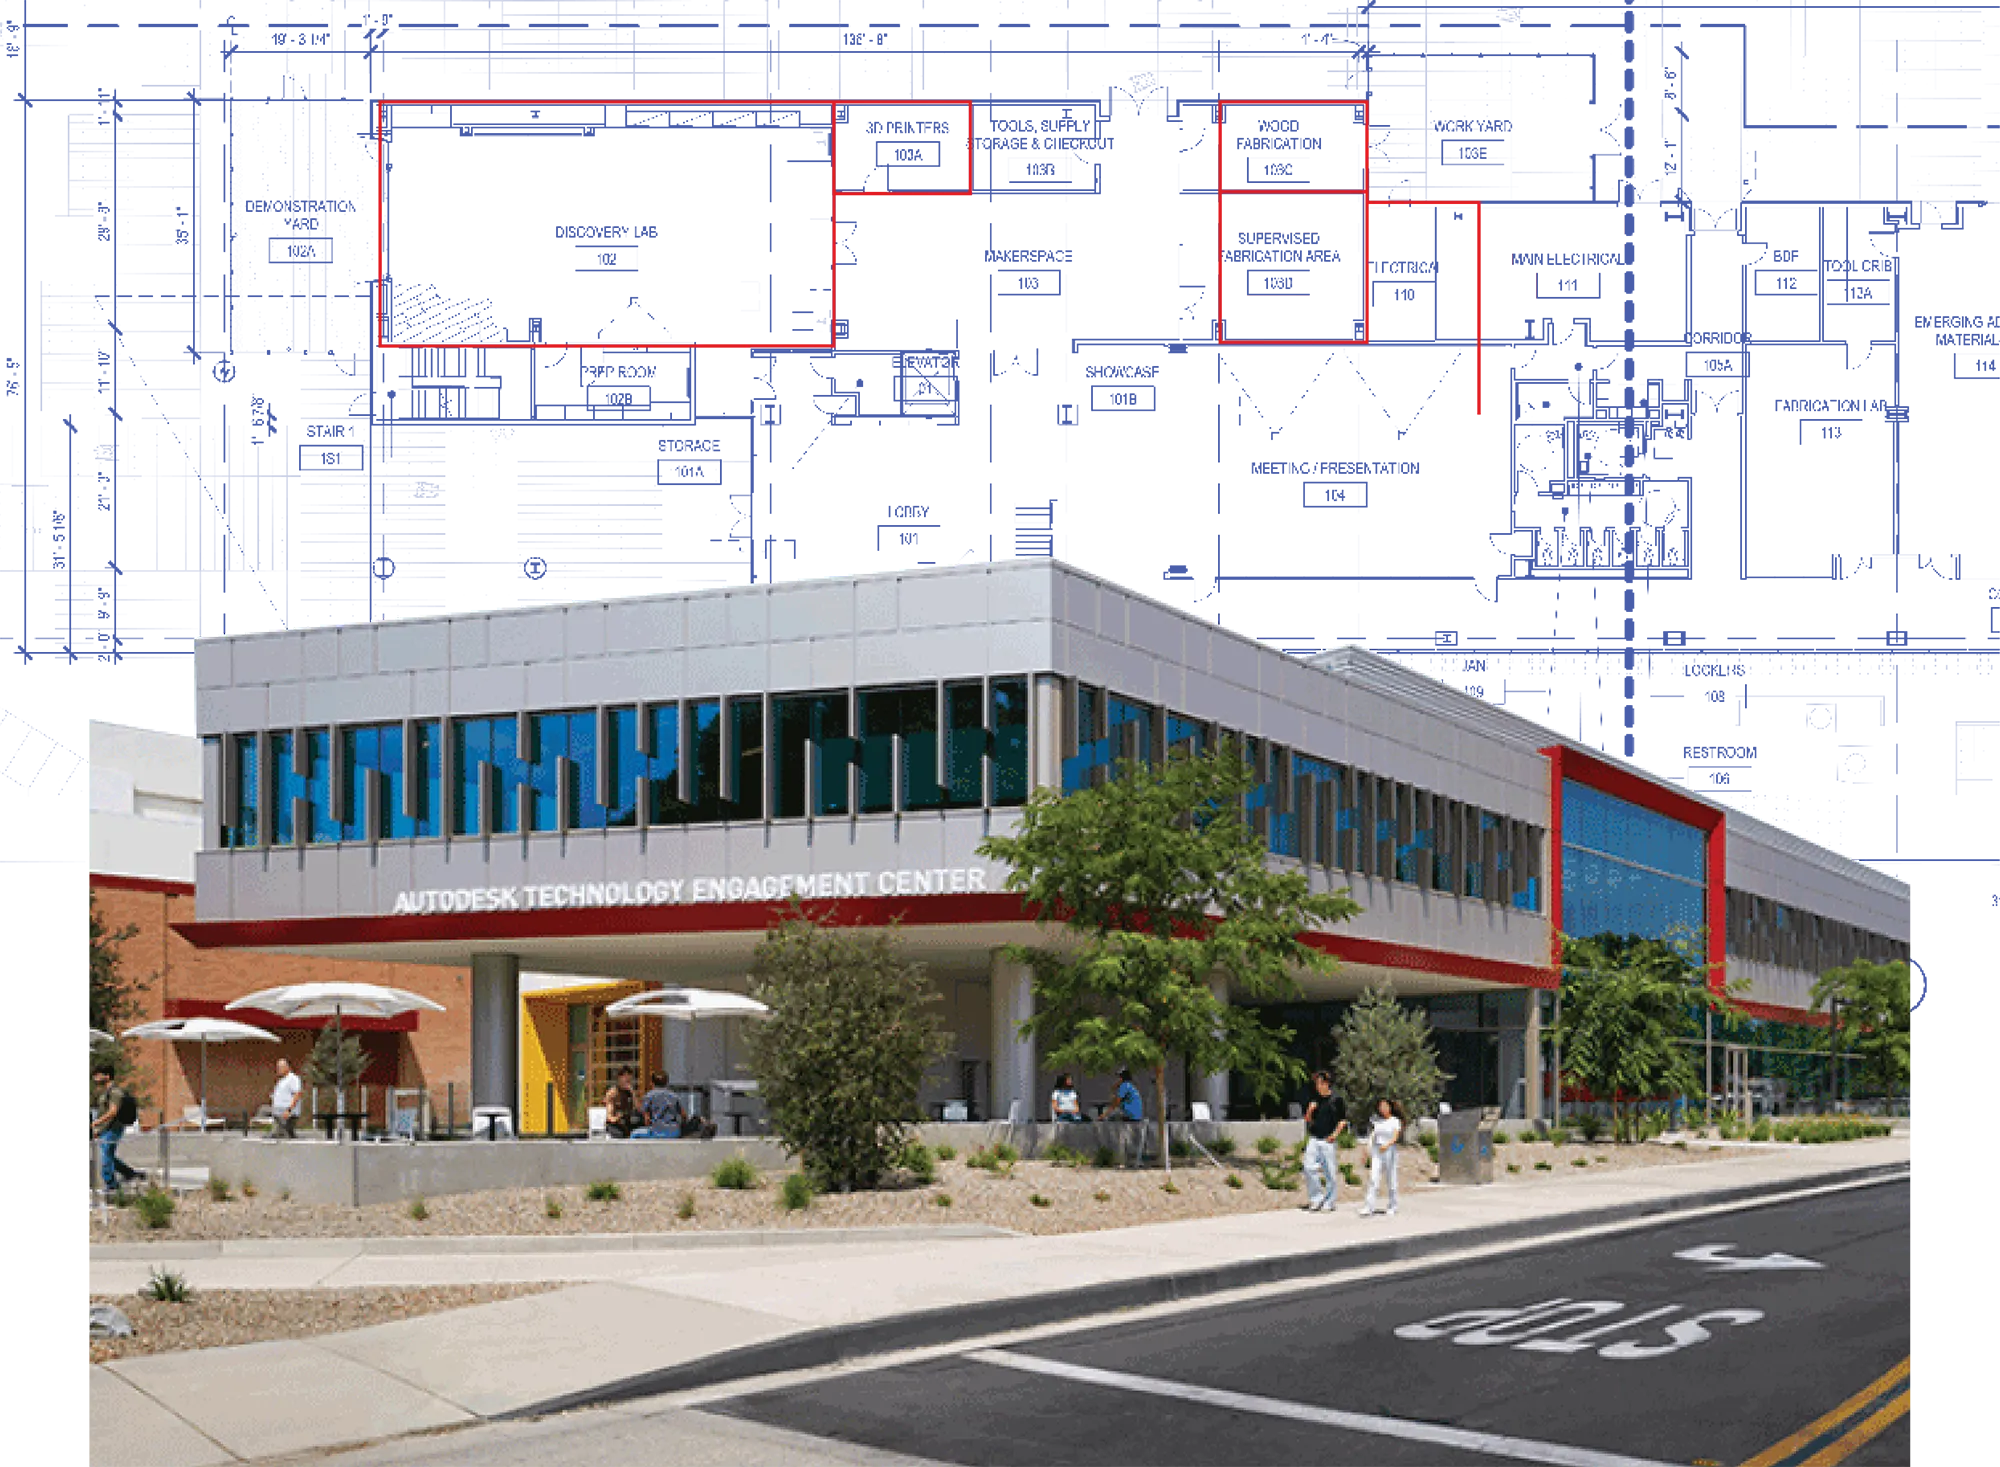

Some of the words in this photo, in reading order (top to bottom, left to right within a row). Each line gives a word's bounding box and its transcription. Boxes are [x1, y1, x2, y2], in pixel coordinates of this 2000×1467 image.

[394, 886, 519, 915] AUTODESK
[523, 879, 685, 909] TECHNOLOGY
[692, 871, 871, 902] ENGAGEMENT
[877, 867, 987, 893] CENTER
[1394, 1298, 1764, 1359] STOP
